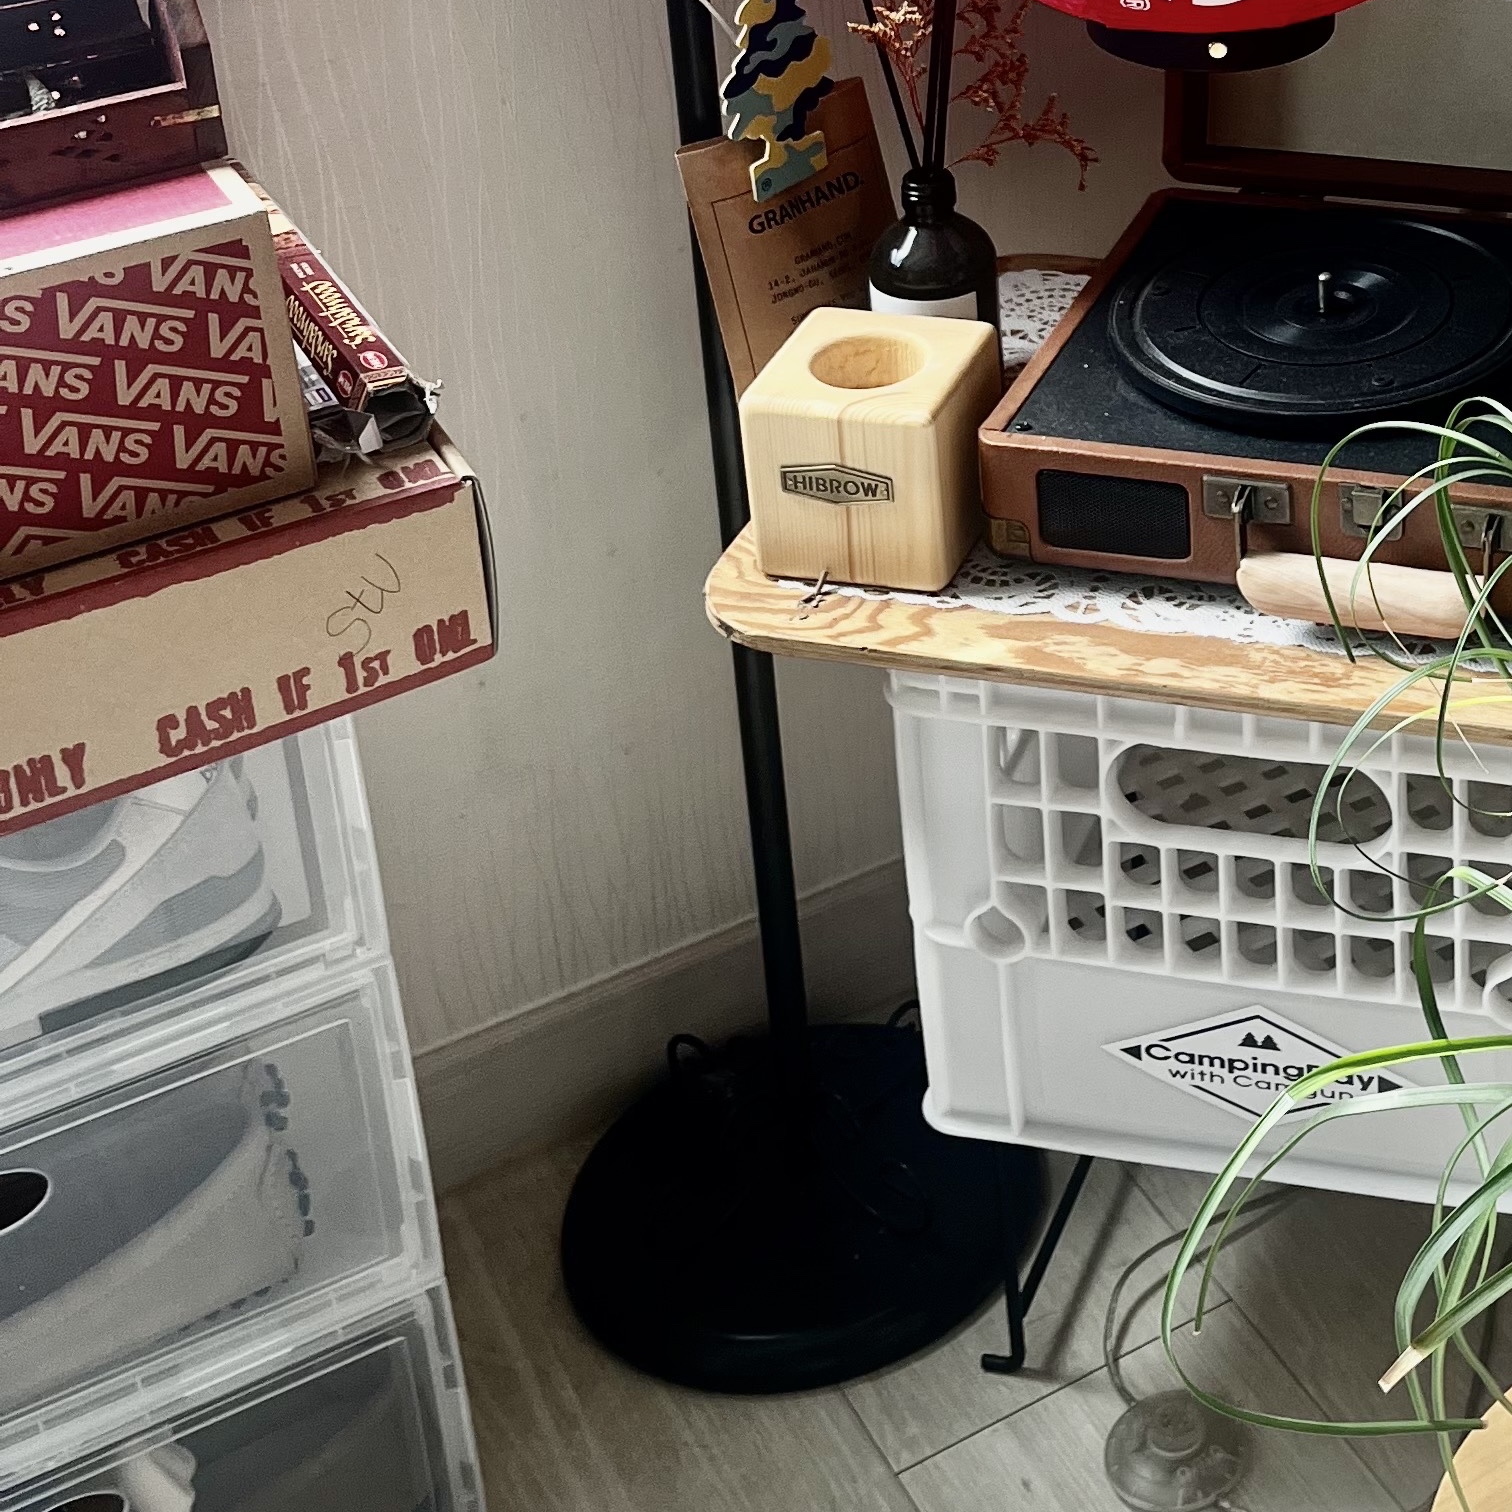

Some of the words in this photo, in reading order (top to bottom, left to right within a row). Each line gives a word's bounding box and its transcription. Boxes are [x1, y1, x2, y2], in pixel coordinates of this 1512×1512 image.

[56, 291, 195, 353] VANS
[114, 359, 250, 418] VANS
[20, 407, 161, 465] VANS
[173, 424, 289, 477] VANS
[792, 474, 879, 498] HIBROW
[156, 686, 258, 758] CASH
[276, 666, 312, 715] IF
[1144, 1043, 1375, 1092] Campingay
[1168, 1068, 1226, 1085] with
